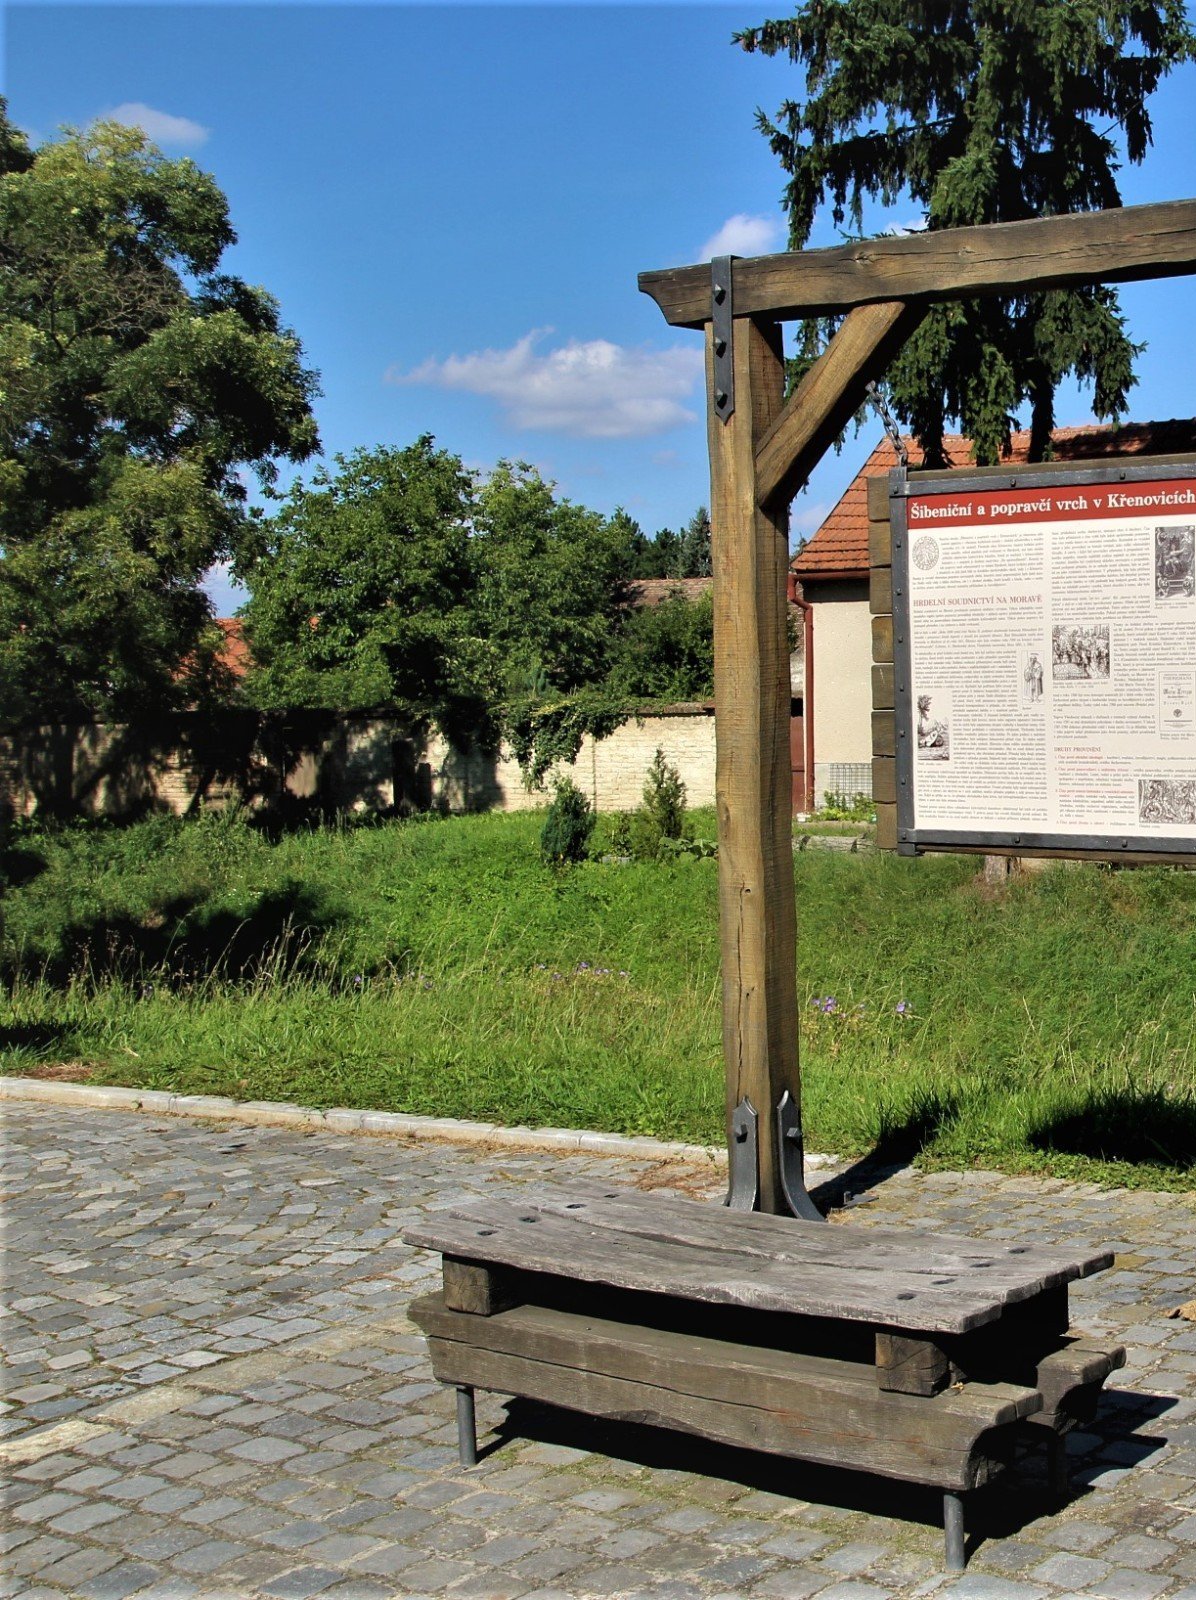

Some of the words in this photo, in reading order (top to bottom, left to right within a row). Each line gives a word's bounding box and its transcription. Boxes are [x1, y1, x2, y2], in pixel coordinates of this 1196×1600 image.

[911, 502, 972, 519] Šibeniční
[977, 506, 985, 515] a
[991, 498, 1051, 517] popravčí
[1056, 495, 1087, 511] vrch
[1093, 498, 1102, 508] v
[1107, 489, 1196, 508] Křenovicích
[913, 597, 946, 607] HRDELNÍ
[947, 595, 994, 606] SOUDNICTVÍ
[996, 596, 1007, 604] NA
[1009, 594, 1043, 604] MORAVĚ
